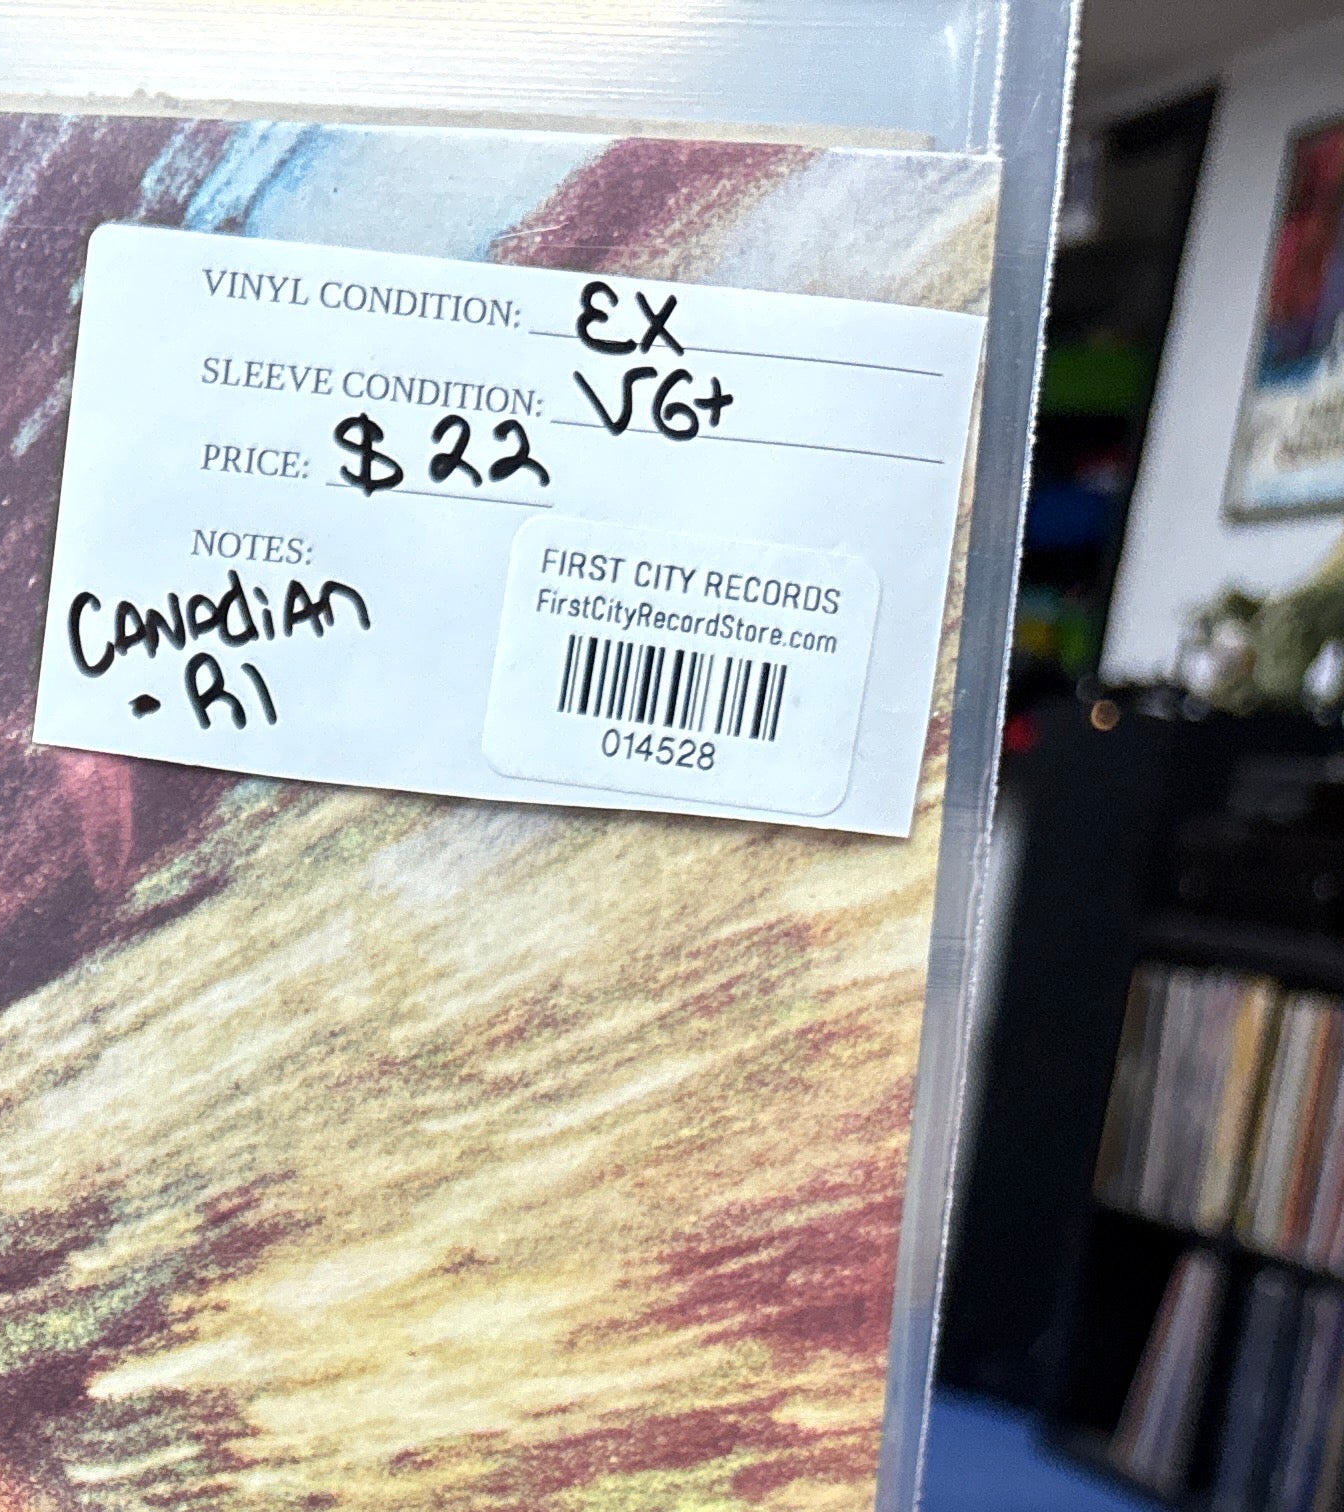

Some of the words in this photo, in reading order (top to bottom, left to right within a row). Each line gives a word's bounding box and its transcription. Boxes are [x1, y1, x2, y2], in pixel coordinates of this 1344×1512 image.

[201, 268, 309, 307] VINYL
[319, 281, 521, 328] CONDITION:
[576, 281, 685, 356] EX
[201, 356, 333, 396] SLEEVE
[342, 371, 543, 418] CONDITION:
[200, 443, 311, 480] PRICE:
[190, 529, 313, 566] NOTES:
[541, 548, 626, 584] FIRST
[633, 561, 697, 594] CITY
[703, 571, 842, 615] RECORDS
[535, 588, 838, 654] FirstCityRecordStore.com
[601, 728, 717, 772] 014528
